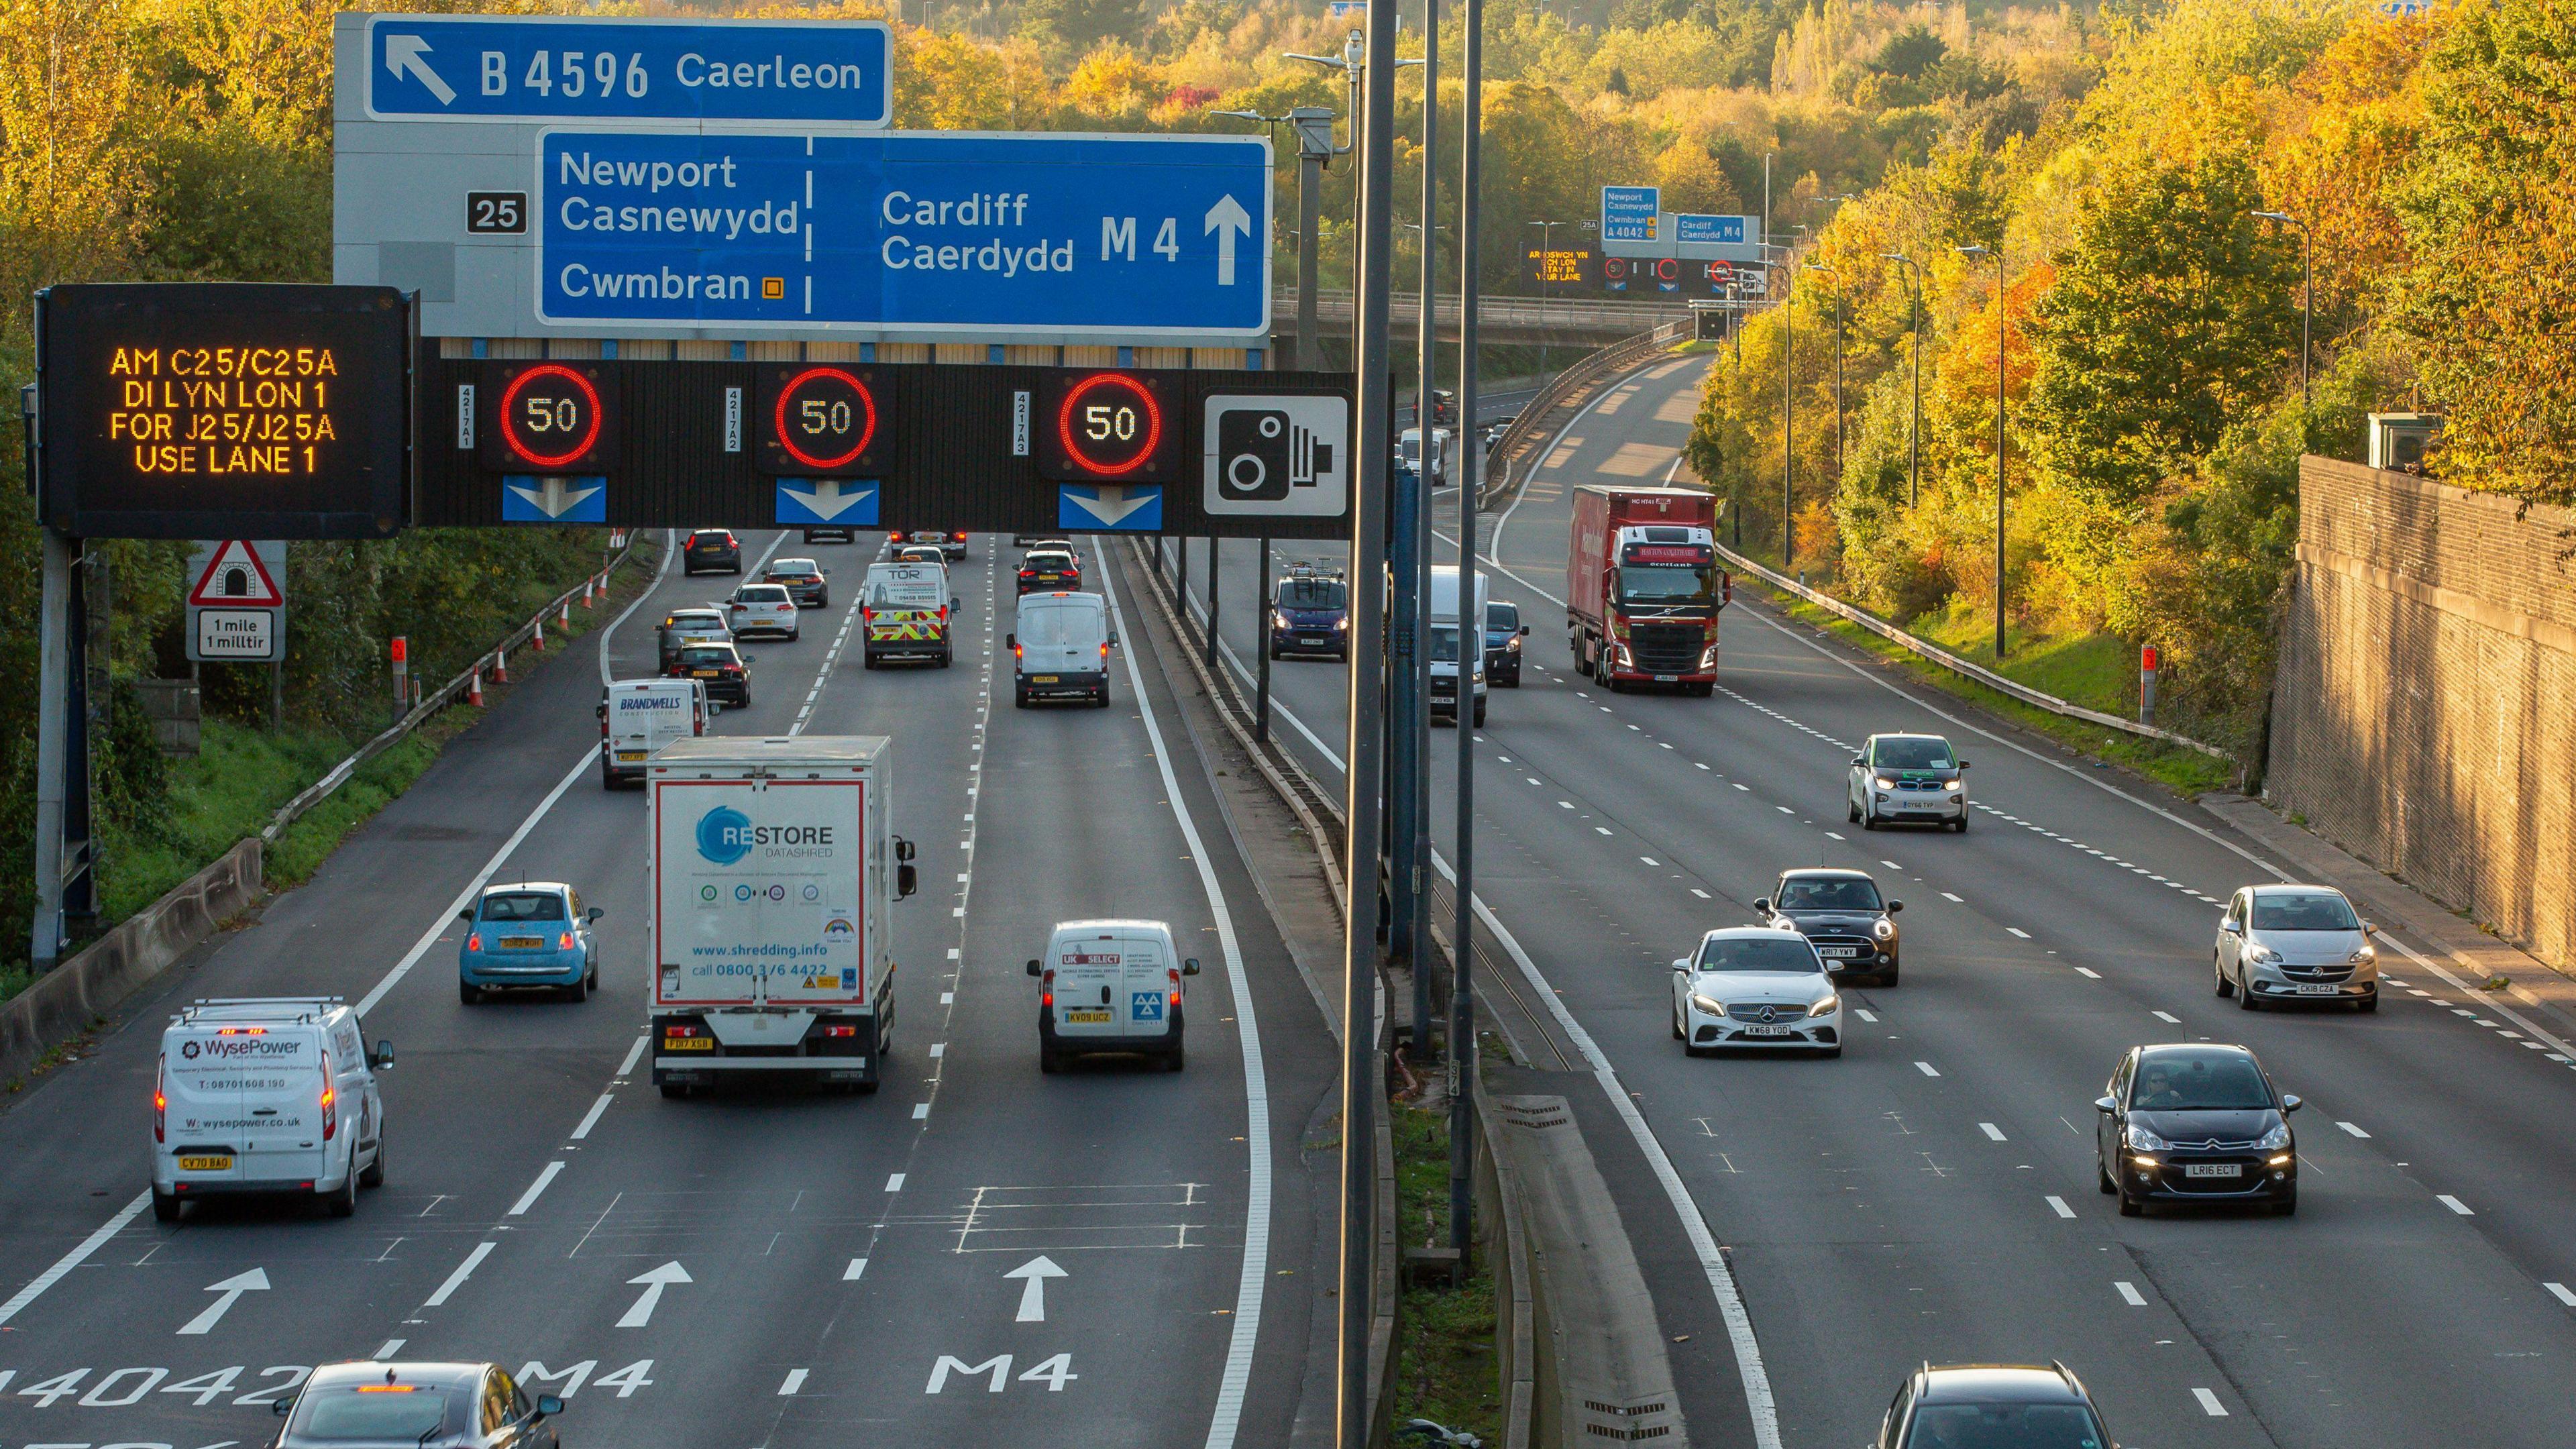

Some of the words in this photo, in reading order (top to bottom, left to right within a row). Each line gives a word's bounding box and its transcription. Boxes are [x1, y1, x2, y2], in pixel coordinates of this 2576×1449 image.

[482, 51, 507, 97] B
[525, 51, 649, 99] 4596
[676, 52, 861, 89] Caerleon
[560, 152, 737, 193] Newport
[1607, 193, 1643, 202] Newport
[882, 191, 1029, 227] Cardiff
[1607, 202, 1654, 211] Casnewydd
[475, 199, 519, 229] 25
[560, 196, 798, 239] Casnewydd
[1607, 215, 1646, 224] Cwmbran
[1681, 221, 1712, 229] Cardiff
[1607, 227, 1615, 237] A
[1616, 227, 1643, 238] 4042
[1681, 231, 1721, 239] Caerdydd
[881, 235, 1073, 278] Caerdydd
[1560, 258, 1576, 266] LON
[1576, 251, 1589, 259] YN
[1609, 264, 1621, 273] 50
[560, 263, 751, 300] Cwmbran
[111, 348, 159, 376] AM
[171, 348, 337, 378] C25/C25A
[125, 380, 153, 408] DI
[165, 380, 226, 408] LYN
[239, 380, 301, 408] LON
[314, 381, 325, 408] 1
[462, 388, 470, 446] 4217A1
[527, 398, 577, 433] 50
[729, 390, 737, 449] 4217A2
[801, 400, 851, 435] 50
[111, 413, 172, 440] FOR
[184, 413, 336, 443] J25/J25A
[1017, 394, 1026, 453] 4217A3
[1085, 406, 1136, 441] 50
[136, 445, 197, 473] USE
[209, 445, 290, 473] LANE
[303, 445, 315, 473] 1
[1642, 548, 1663, 556] HAYTON
[1663, 549, 1695, 557] COULTHARD
[888, 570, 920, 580] TOR
[214, 619, 221, 632] 1
[225, 619, 258, 633] mile
[207, 636, 213, 648] 1
[217, 635, 264, 649] milltir
[620, 697, 681, 710] BRANDWELLS
[722, 826, 834, 845] RESTORE
[765, 847, 834, 858] DATASHRED
[692, 943, 828, 959] www.shredding.info
[1820, 947, 1838, 957] WR17
[1838, 947, 1854, 957] YWY
[1063, 955, 1077, 964] UK
[1087, 955, 1118, 964] SELECT
[692, 964, 713, 976] call
[716, 964, 754, 976] 0800
[790, 963, 828, 975] 4422
[2300, 985, 2318, 994] CK18
[2319, 985, 2334, 993] CZA
[1070, 1013, 1091, 1022] KV09
[1093, 1012, 1111, 1022] UCZ
[1748, 1025, 1770, 1035] KW68
[1771, 1025, 1788, 1034] YOD
[205, 1039, 301, 1059] WysePower
[268, 1079, 285, 1088] 190
[203, 1118, 301, 1130] wysepower.co.uk
[182, 1158, 207, 1167] CV70
[2192, 1165, 2214, 1175] LR16
[2216, 1165, 2236, 1175] ECT
[513, 1358, 655, 1399] M4
[925, 1352, 1079, 1394] M4
